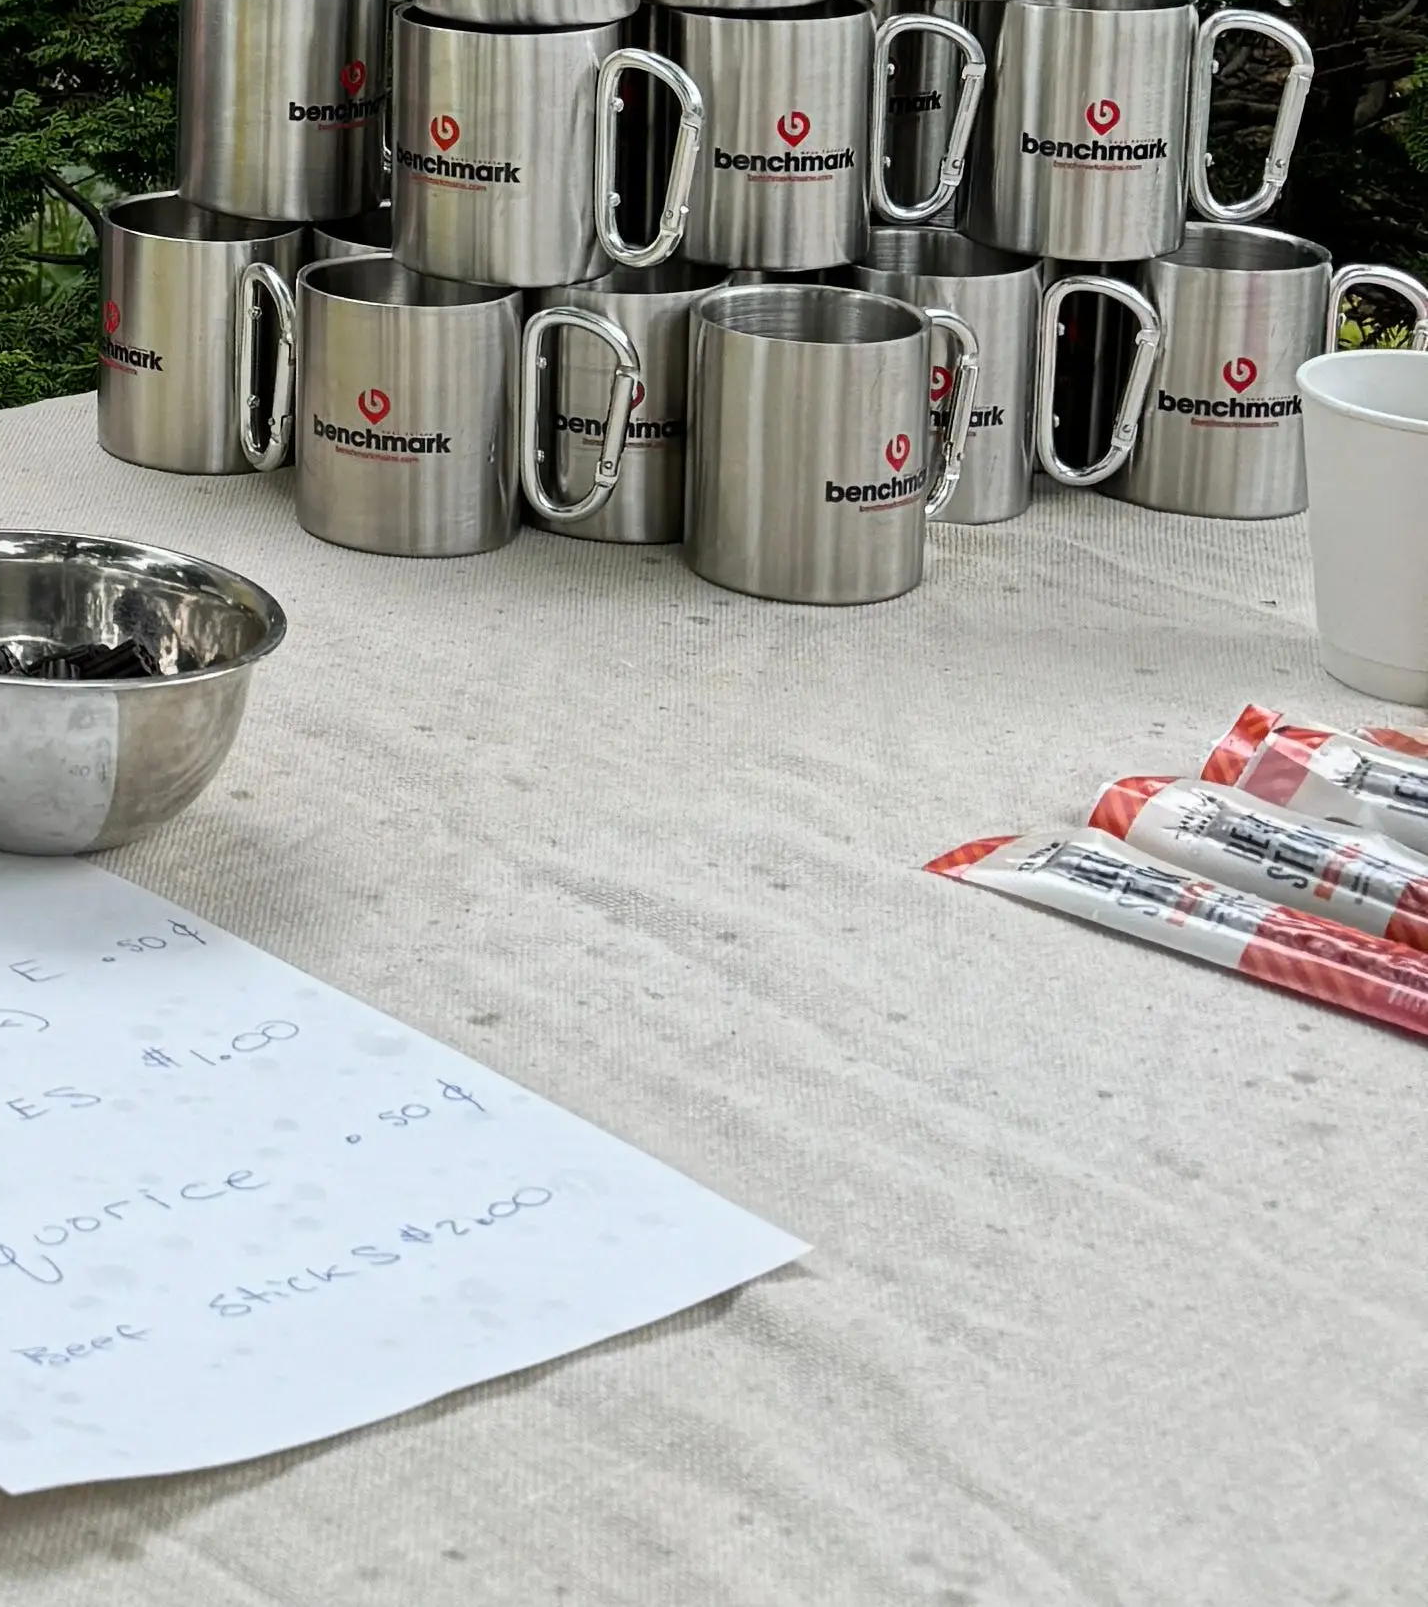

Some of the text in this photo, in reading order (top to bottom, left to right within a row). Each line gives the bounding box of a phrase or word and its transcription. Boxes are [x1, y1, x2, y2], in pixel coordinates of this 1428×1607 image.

[714, 147, 855, 172] benchmark
[1022, 132, 1168, 160] benchmark
[396, 142, 521, 183] benchmark
[1158, 390, 1302, 418] benchmark
[313, 414, 452, 453] benchmark
